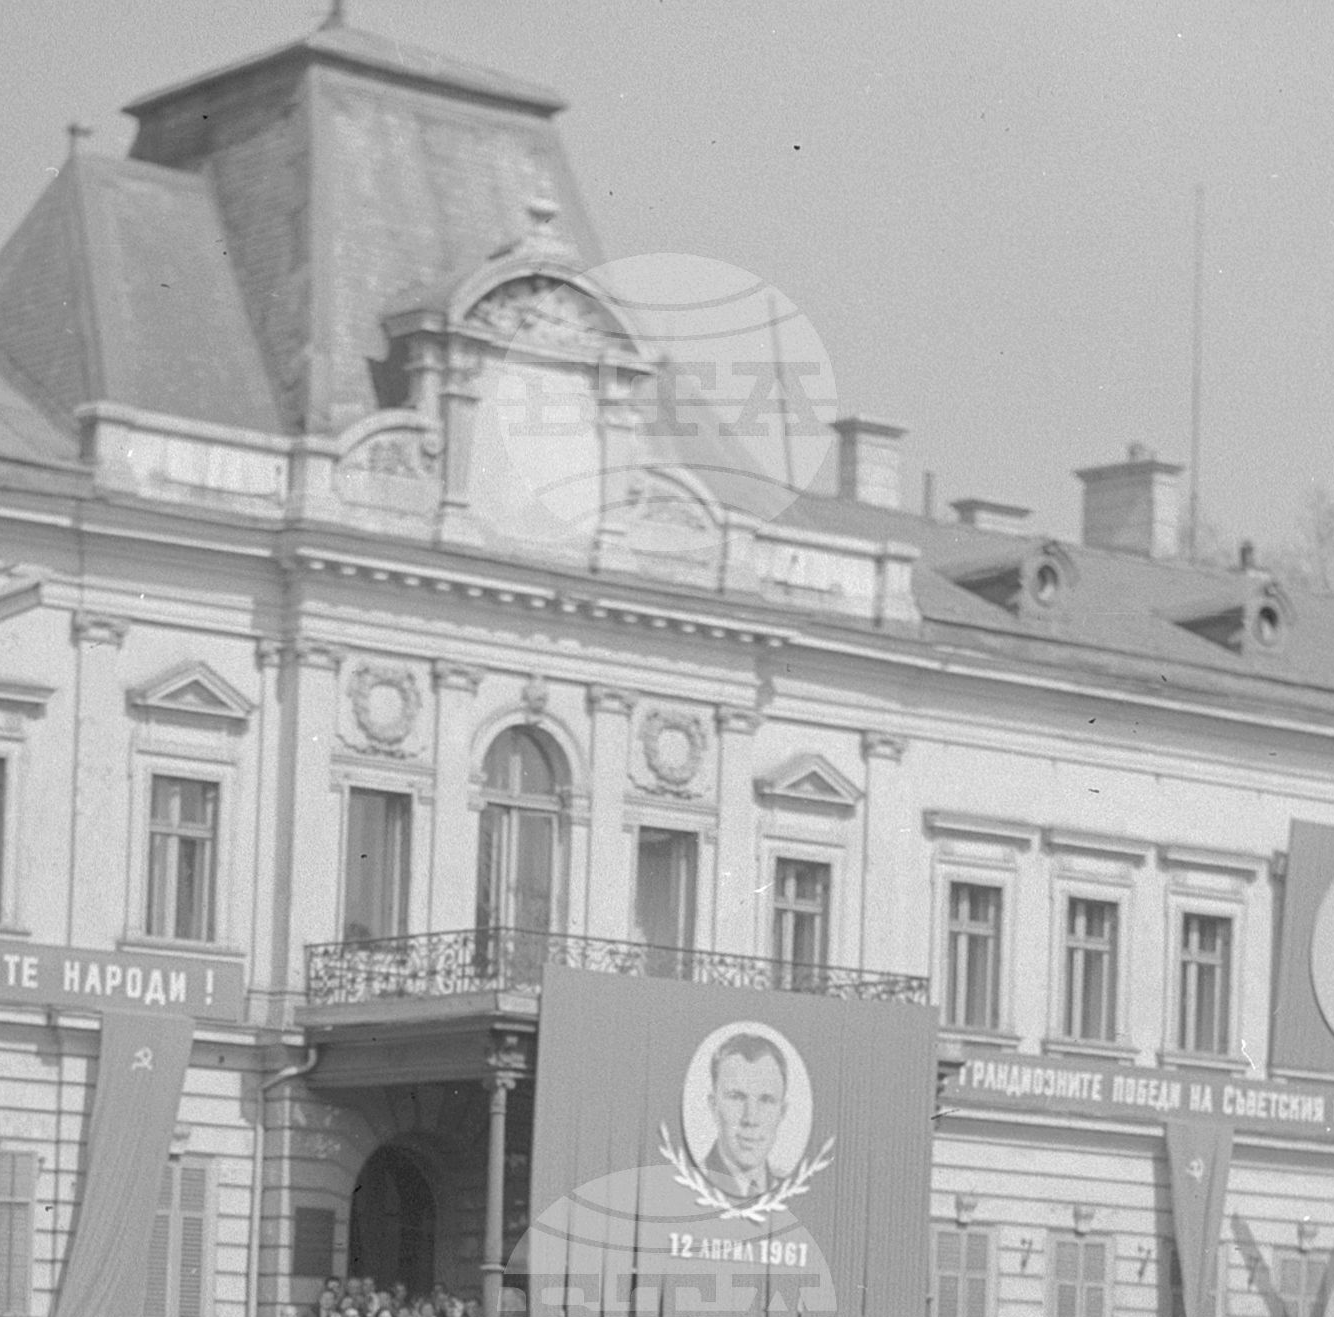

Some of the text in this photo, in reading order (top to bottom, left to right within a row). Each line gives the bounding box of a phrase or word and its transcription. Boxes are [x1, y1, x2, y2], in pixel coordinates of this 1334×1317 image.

[1113, 1075, 1180, 1110] ПОБЕДИ
[1190, 1085, 1213, 1113] НА
[1223, 1086, 1324, 1123] СЪВЕТСКИЯ
[670, 1233, 808, 1266] 12 АПРИЛ 1961
